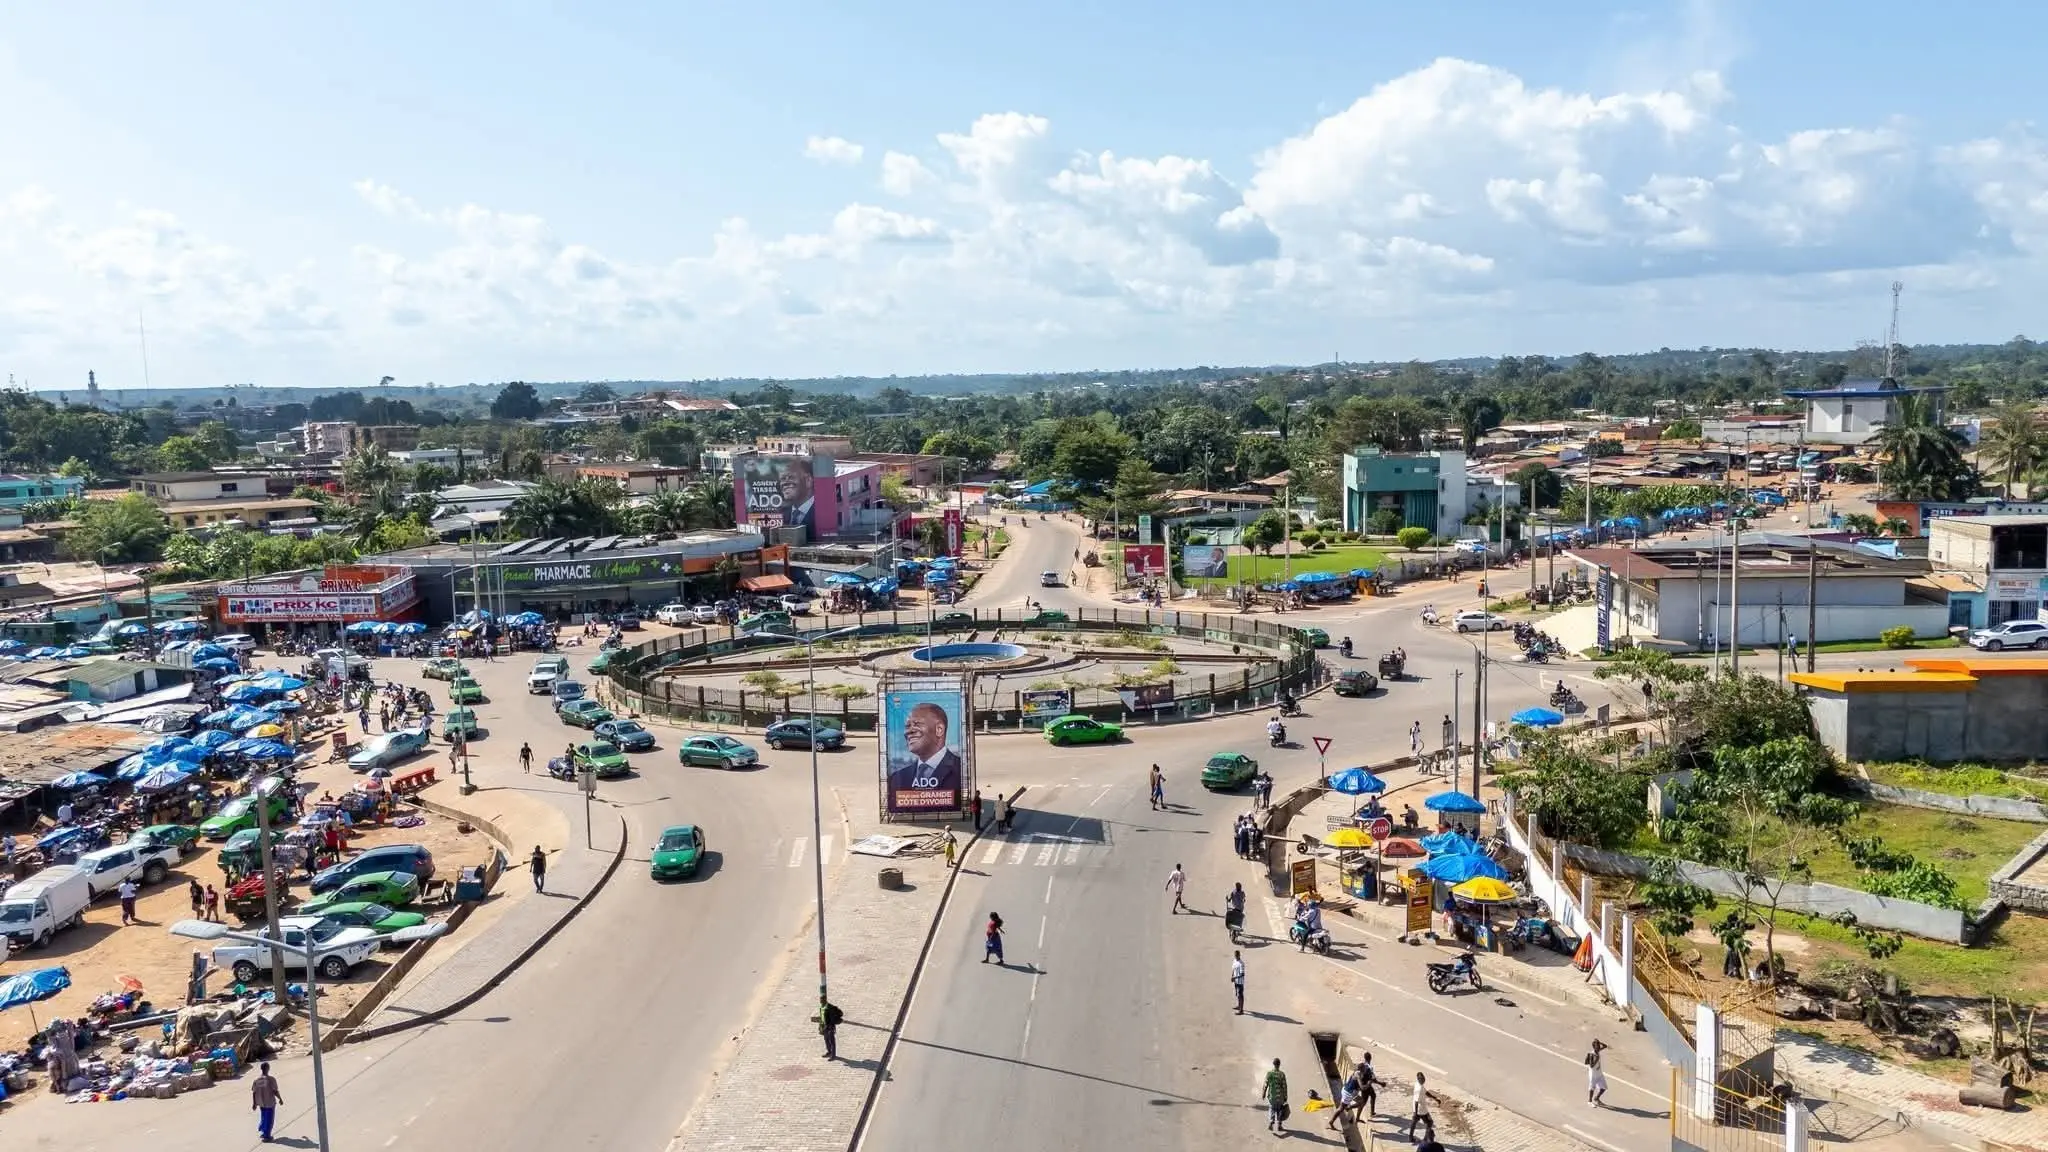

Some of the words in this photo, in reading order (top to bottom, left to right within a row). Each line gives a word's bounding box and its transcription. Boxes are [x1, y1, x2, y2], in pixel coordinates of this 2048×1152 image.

[748, 494, 782, 507] ADO
[534, 564, 592, 581] PHARMACIE
[592, 567, 602, 579] de
[217, 585, 246, 594] CENTRE
[247, 584, 294, 593] COMMERCIAL
[273, 601, 313, 609] PRIX
[316, 600, 338, 609] KC
[911, 777, 938, 787] ADO
[898, 797, 919, 805] CÔTE
[1373, 823, 1389, 834] STOP
